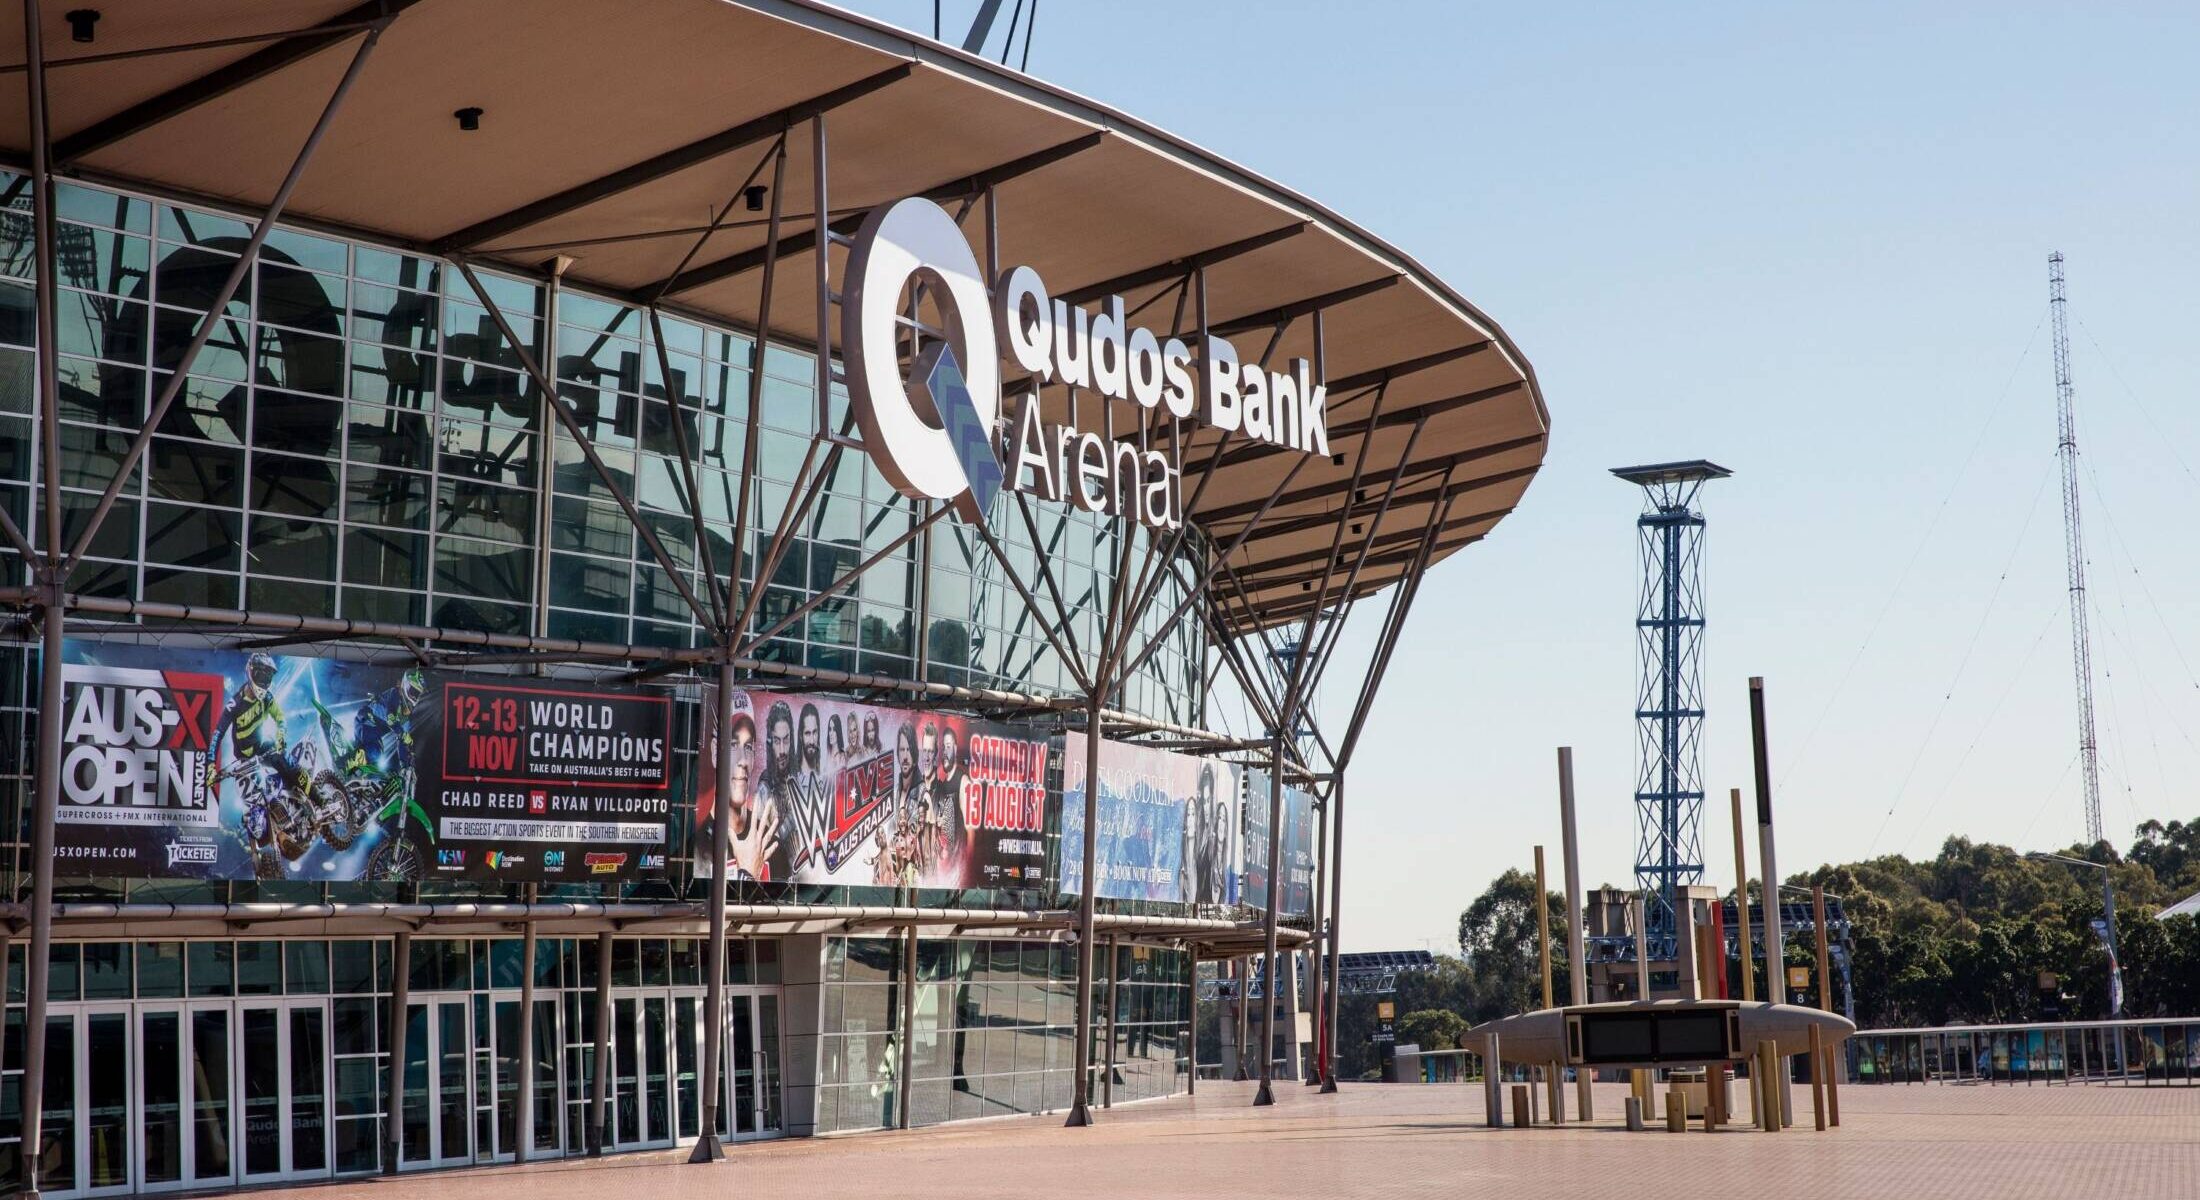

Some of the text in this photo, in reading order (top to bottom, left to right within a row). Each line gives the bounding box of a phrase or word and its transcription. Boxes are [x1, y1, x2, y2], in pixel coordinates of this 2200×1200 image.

[1003, 265, 1331, 457] Qudos Bank
[1007, 393, 1183, 530] Arena
[64, 685, 208, 750] AUS-X
[453, 696, 517, 732] 12-13
[531, 701, 613, 730] WORLD
[469, 735, 517, 771] NOV
[530, 732, 663, 762] CHAMPIONS
[970, 734, 1048, 785] SATURDAY
[62, 745, 194, 807] OPEN
[194, 752, 206, 808] SYDNEY
[530, 763, 549, 774] TAKE
[551, 764, 562, 775] ON
[564, 765, 613, 777] AUSTRALIA'S
[615, 767, 633, 778] BEST
[641, 768, 662, 778] MORE
[1073, 760, 1112, 798] DTA
[442, 791, 668, 813] CHAD REED VS RYAN VILLOPOTO
[828, 753, 894, 843] LIVE
[963, 783, 983, 829] 13
[984, 783, 1046, 832] AUGUST
[57, 810, 113, 820] SUPERCROSS
[123, 812, 140, 820] FMX
[144, 813, 208, 823] INTERNATIONAL
[450, 822, 659, 840] THE BIGGEST ACTION SPORTS EVENT IN THE SOUTHERN HEMISPHERE
[838, 797, 892, 861] AUSTRALIA
[53, 847, 136, 858] USXOPEN.COM
[171, 847, 216, 860] TICKETEK
[1113, 866, 1130, 881] BOOK
[1132, 867, 1147, 882] NOW
[1797, 993, 1804, 1003] 8
[246, 1120, 279, 1131] Qudo
